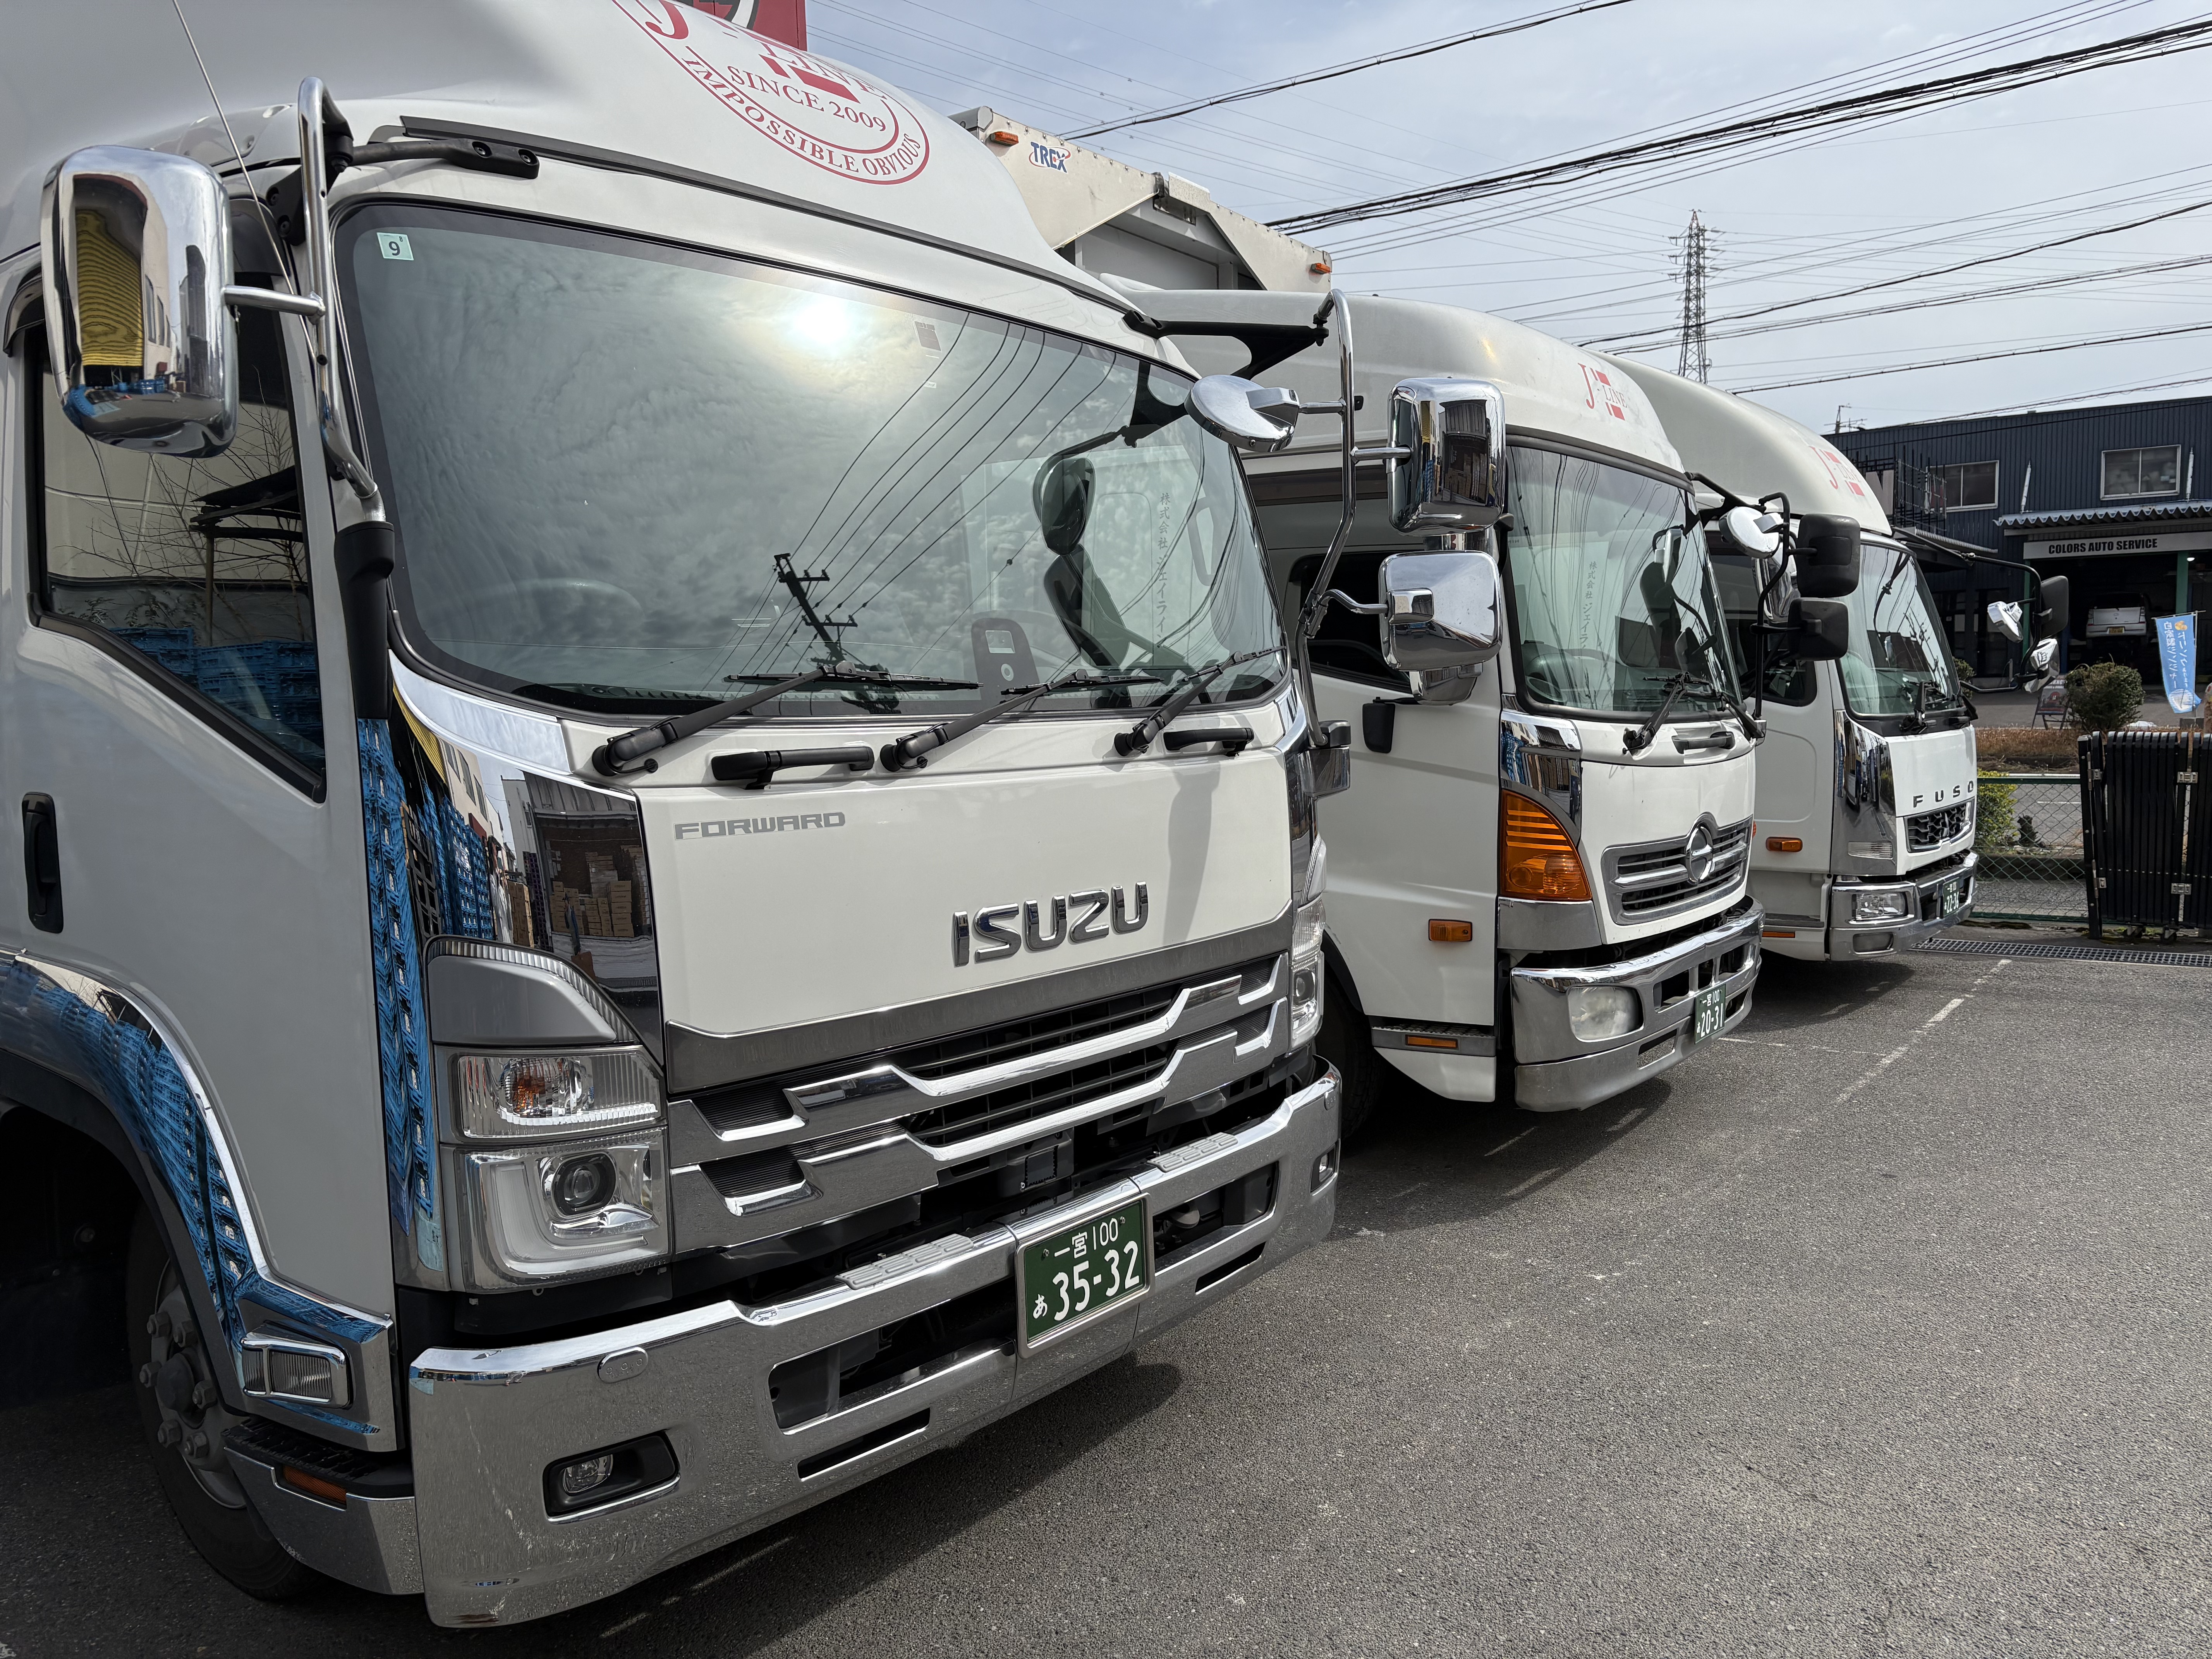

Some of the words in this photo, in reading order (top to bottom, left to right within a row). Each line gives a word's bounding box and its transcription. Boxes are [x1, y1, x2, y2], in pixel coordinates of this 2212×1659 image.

[682, 58, 859, 173] IMPOSSIBLE
[862, 133, 921, 175] OBVIOUS
[727, 65, 824, 112] SINCE
[829, 101, 886, 131] 2009
[1030, 141, 1067, 173] TREX
[389, 241, 400, 256] 9
[2049, 543, 2086, 554] COLORS
[2088, 541, 2114, 552] AUTO
[2116, 538, 2158, 550] SERVICE
[1156, 492, 1171, 638] 株式会社ジェイライ
[1913, 780, 1974, 808] FUSO
[675, 812, 845, 840] FORWARD
[953, 881, 1149, 967] ISUZU
[1701, 1003, 1723, 1038] 20-31
[1054, 1232, 1087, 1258] 一宮
[1093, 1218, 1118, 1250] 100
[1033, 1294, 1048, 1319] あ
[1053, 1240, 1140, 1321] 35-32
